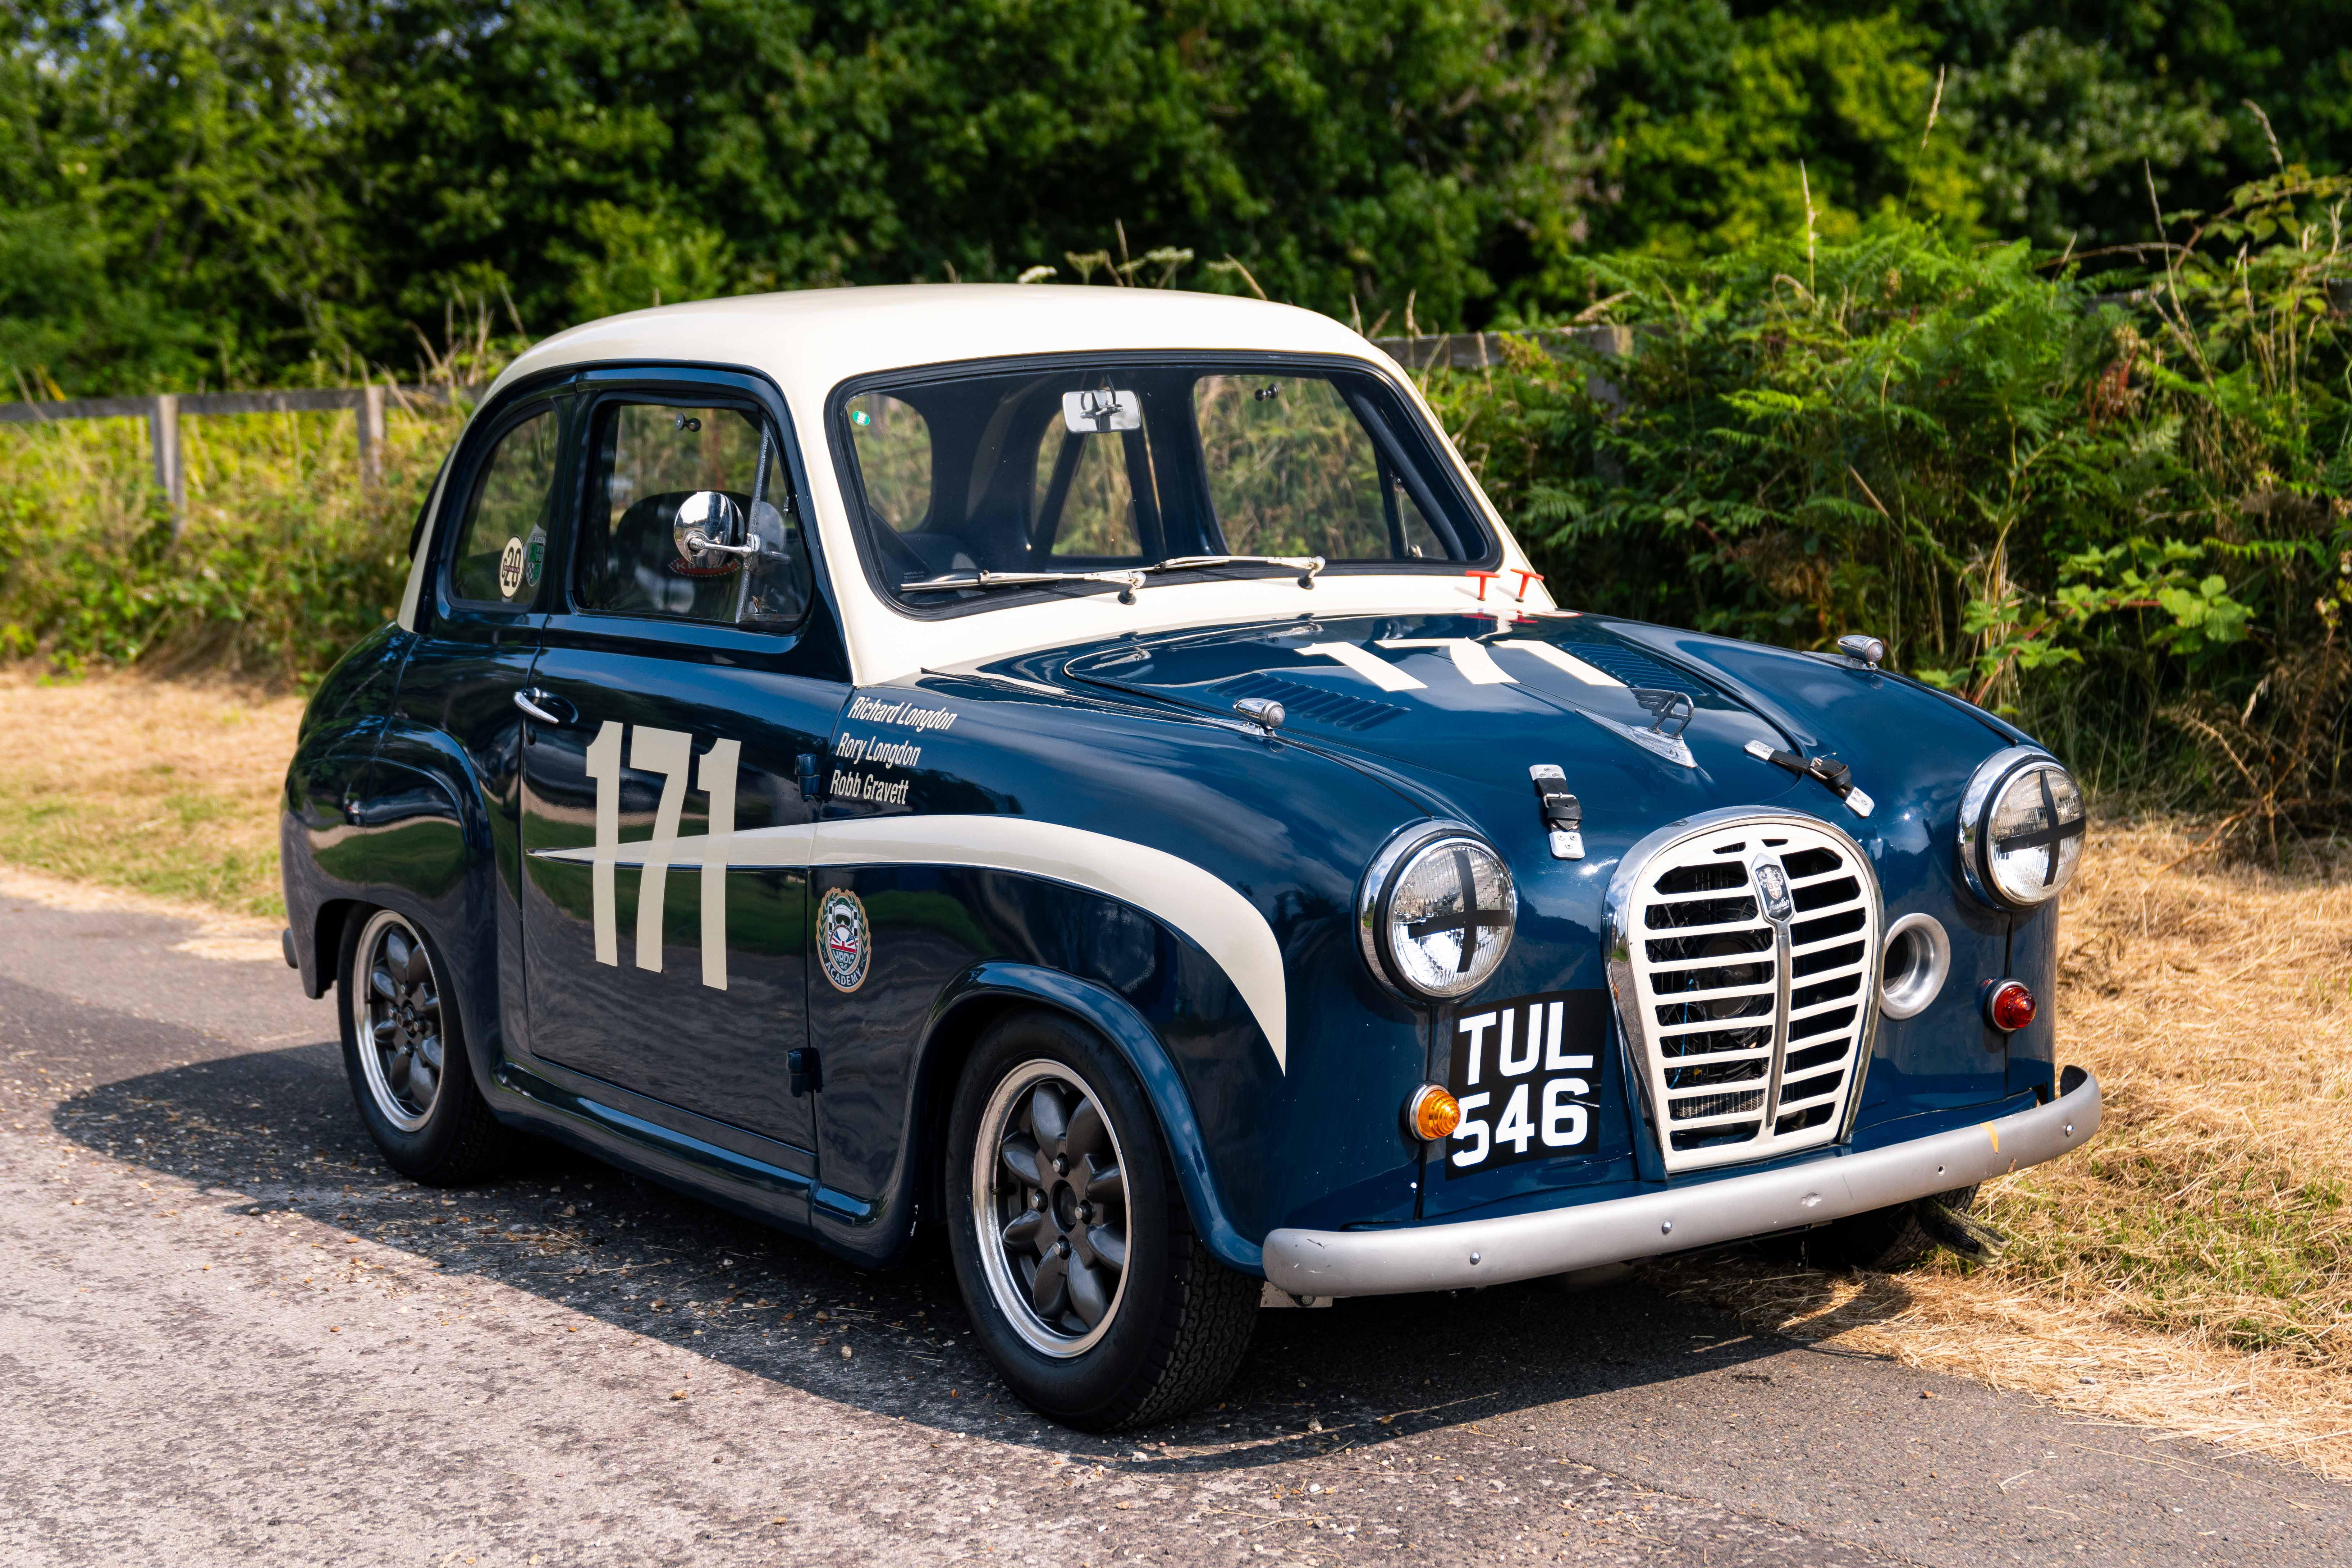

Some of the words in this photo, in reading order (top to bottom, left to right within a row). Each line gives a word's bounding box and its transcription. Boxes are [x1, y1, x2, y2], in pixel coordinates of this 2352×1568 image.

[1294, 636, 1629, 692] 171
[847, 696, 904, 724] Richard
[896, 702, 958, 732] Longdon
[836, 732, 867, 764] Rory
[865, 736, 921, 769] Longdon
[830, 769, 861, 798] Robb
[863, 774, 909, 804] Gravett
[586, 720, 742, 991] 171
[1769, 897, 1790, 912] Austin
[825, 962, 861, 986] ACADEMY
[832, 950, 855, 964] HRDC
[1459, 1001, 1594, 1085] TUL
[1452, 1078, 1591, 1168] 546
